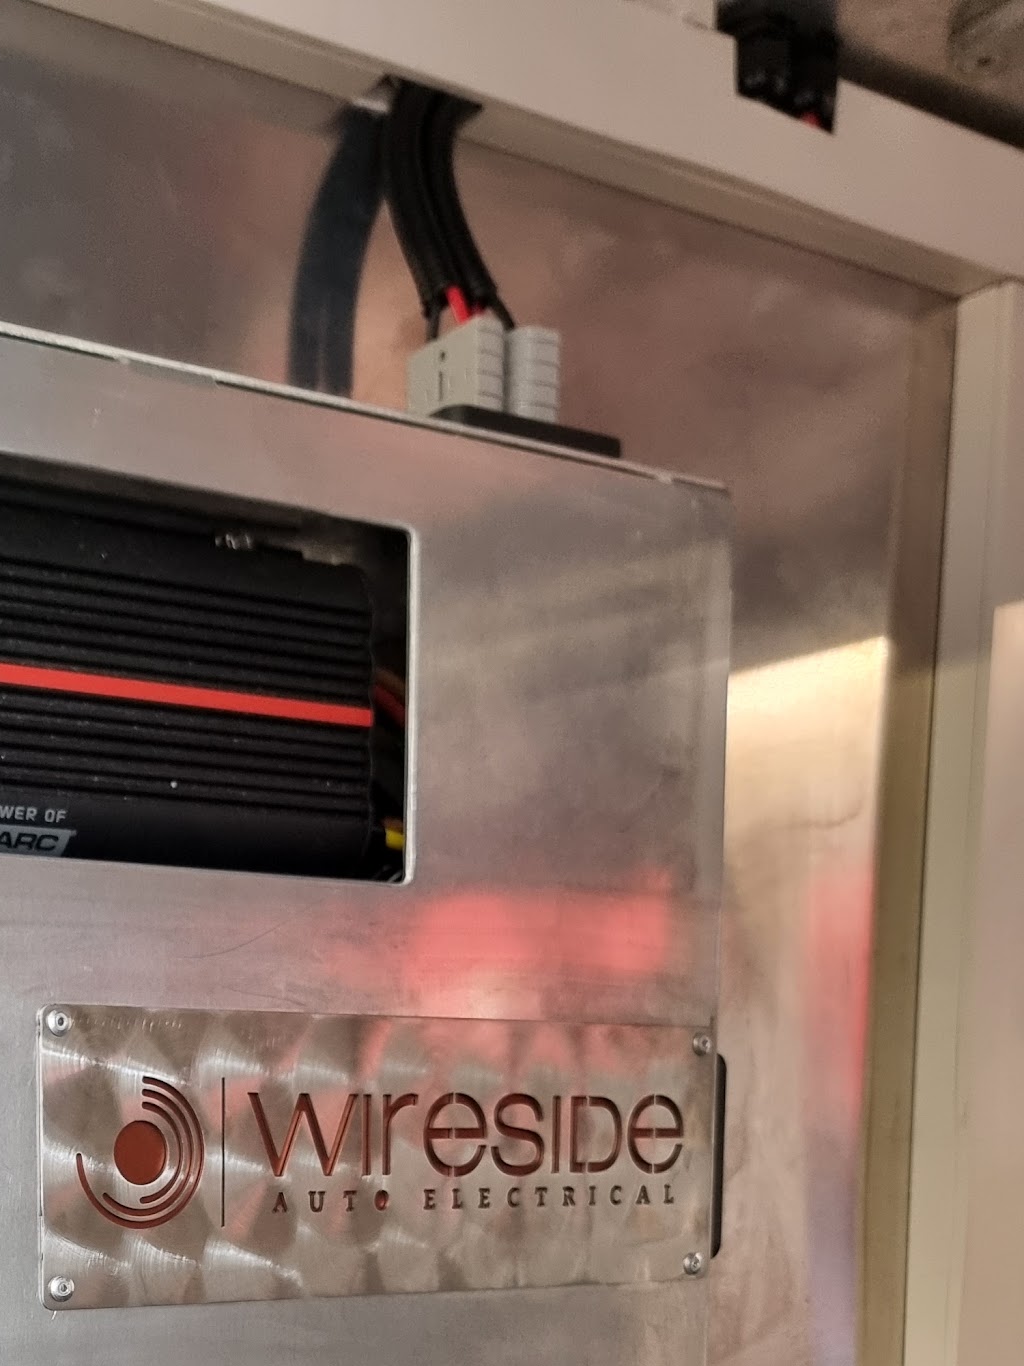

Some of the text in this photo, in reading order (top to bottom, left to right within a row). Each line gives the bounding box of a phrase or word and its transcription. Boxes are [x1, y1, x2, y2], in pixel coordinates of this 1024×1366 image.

[44, 808, 67, 823] OF
[271, 1182, 676, 1214] AUTO ELECTRICAL
